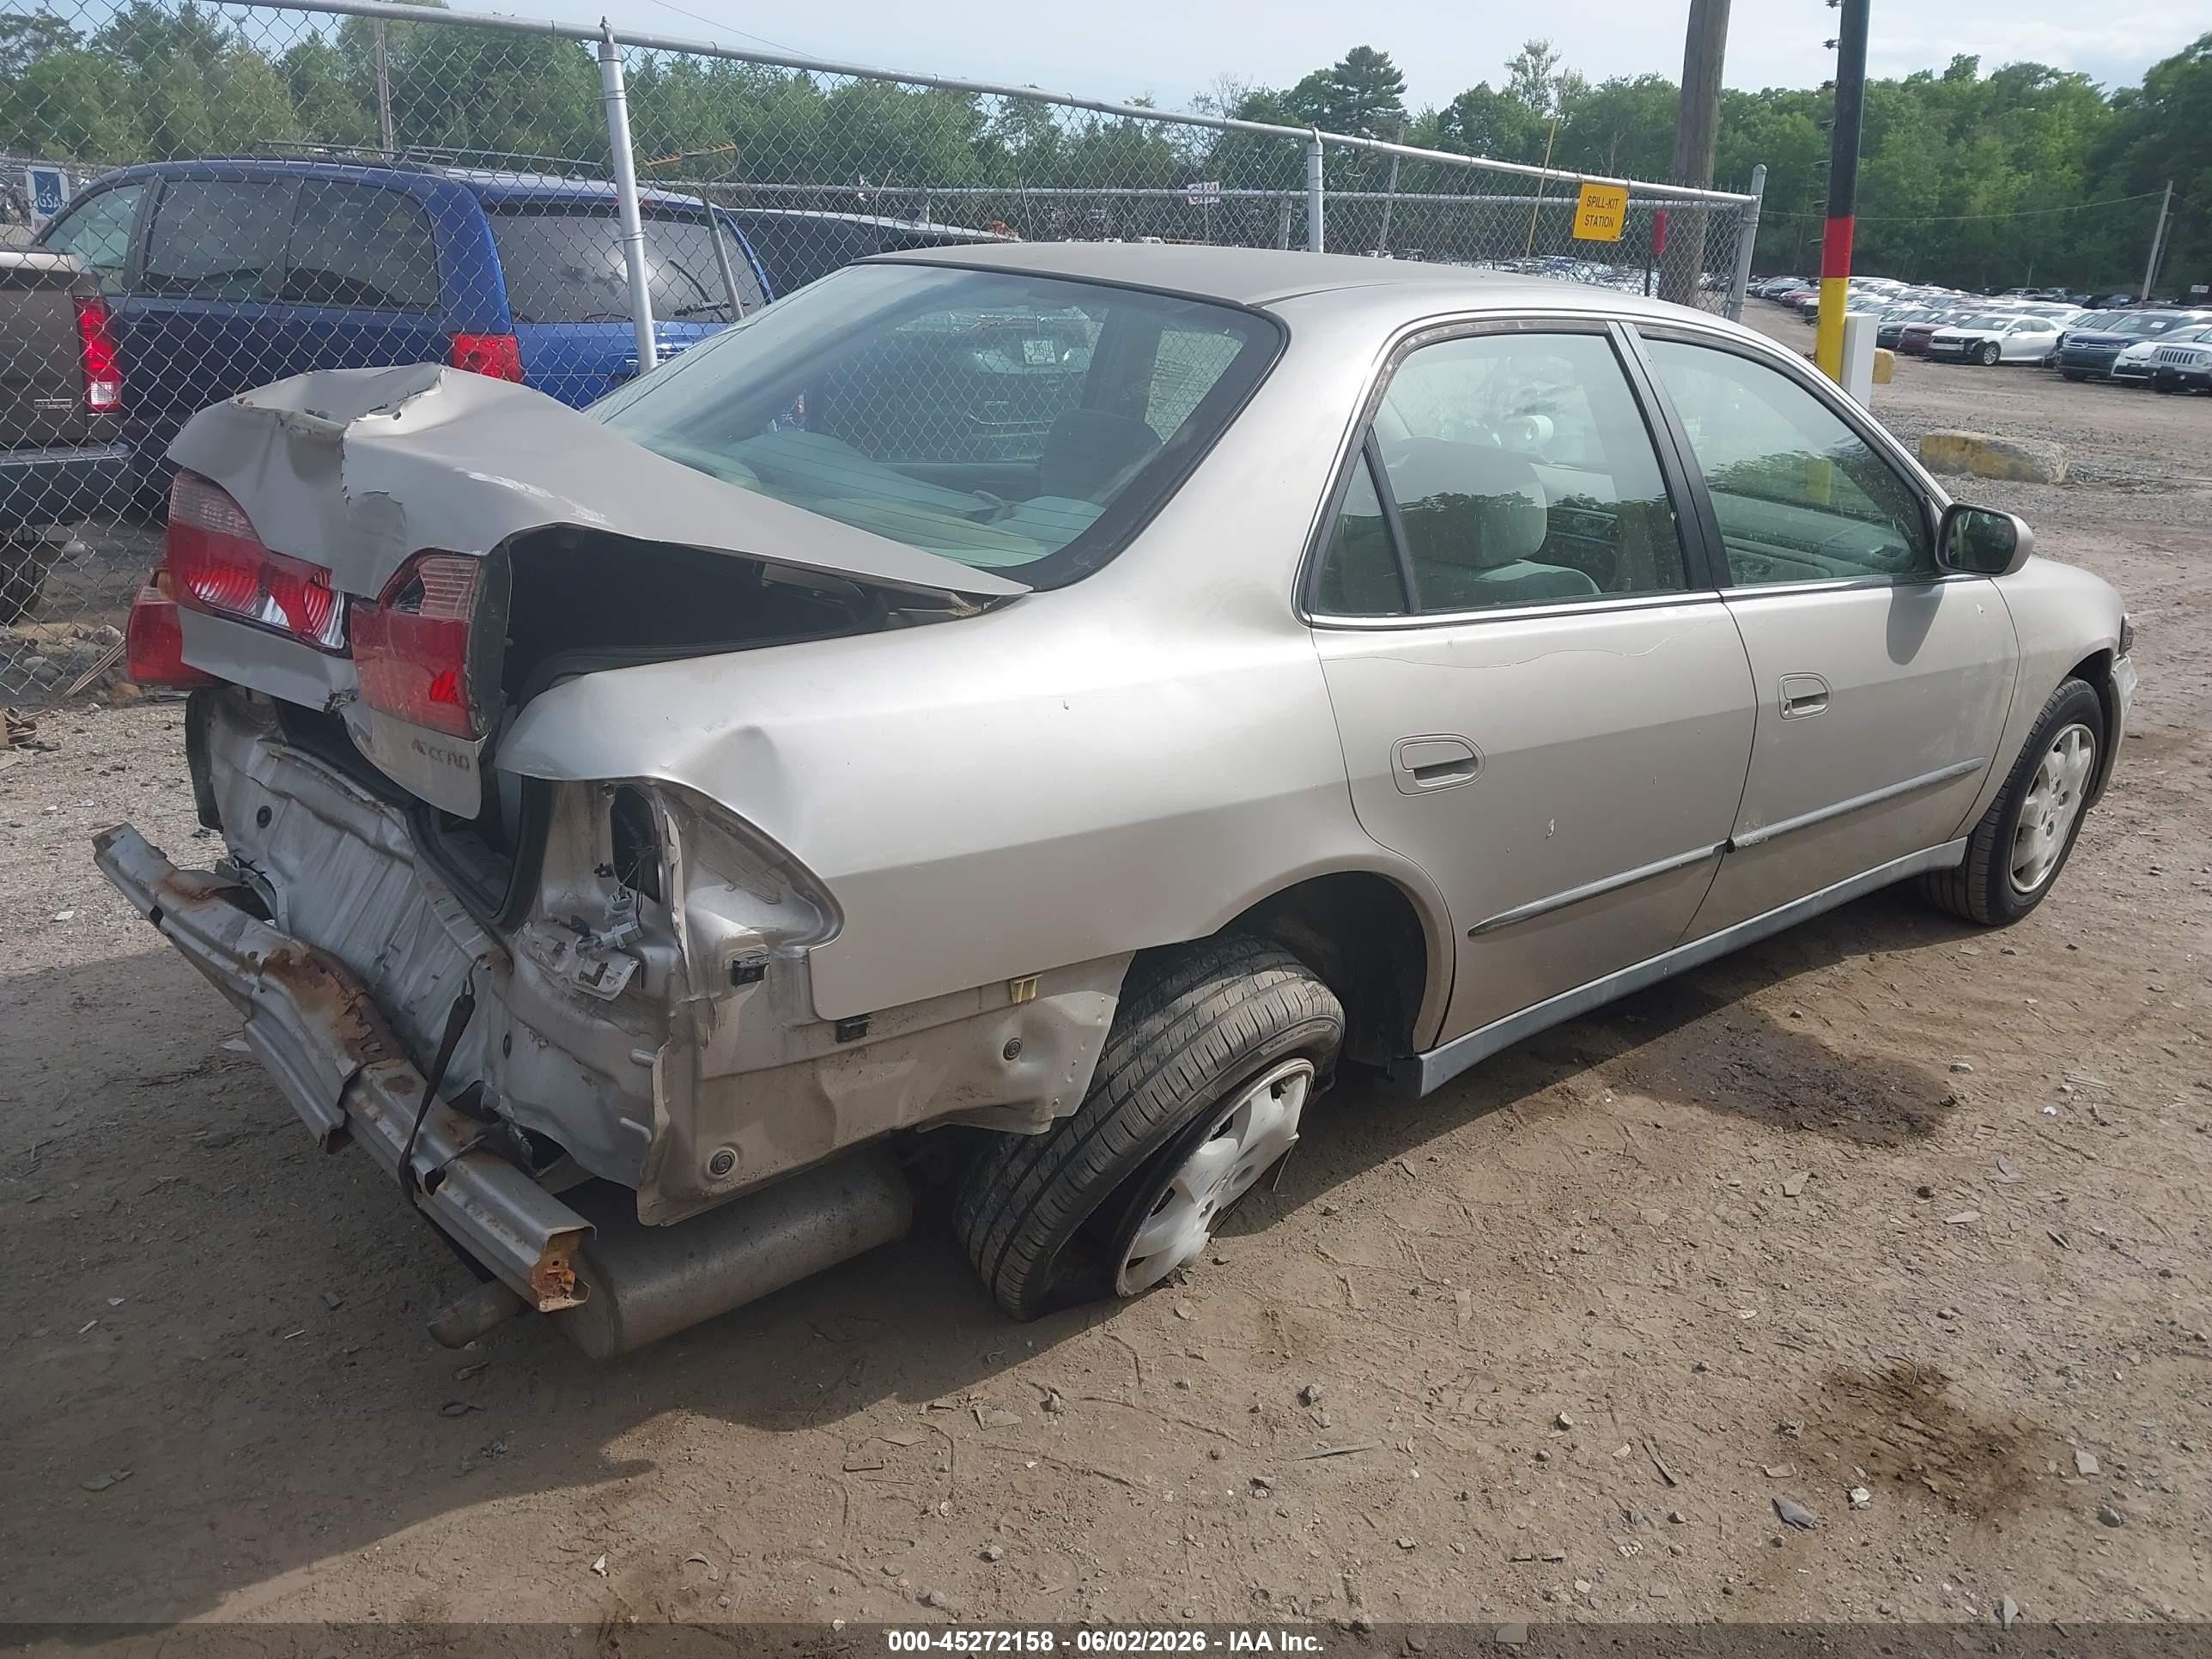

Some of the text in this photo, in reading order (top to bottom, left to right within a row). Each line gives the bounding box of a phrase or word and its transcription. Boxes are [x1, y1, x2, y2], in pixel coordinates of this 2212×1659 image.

[38, 193, 62, 208] GSA
[1586, 195, 1620, 210] SPILL-KIT
[1584, 215, 1614, 228] STATION
